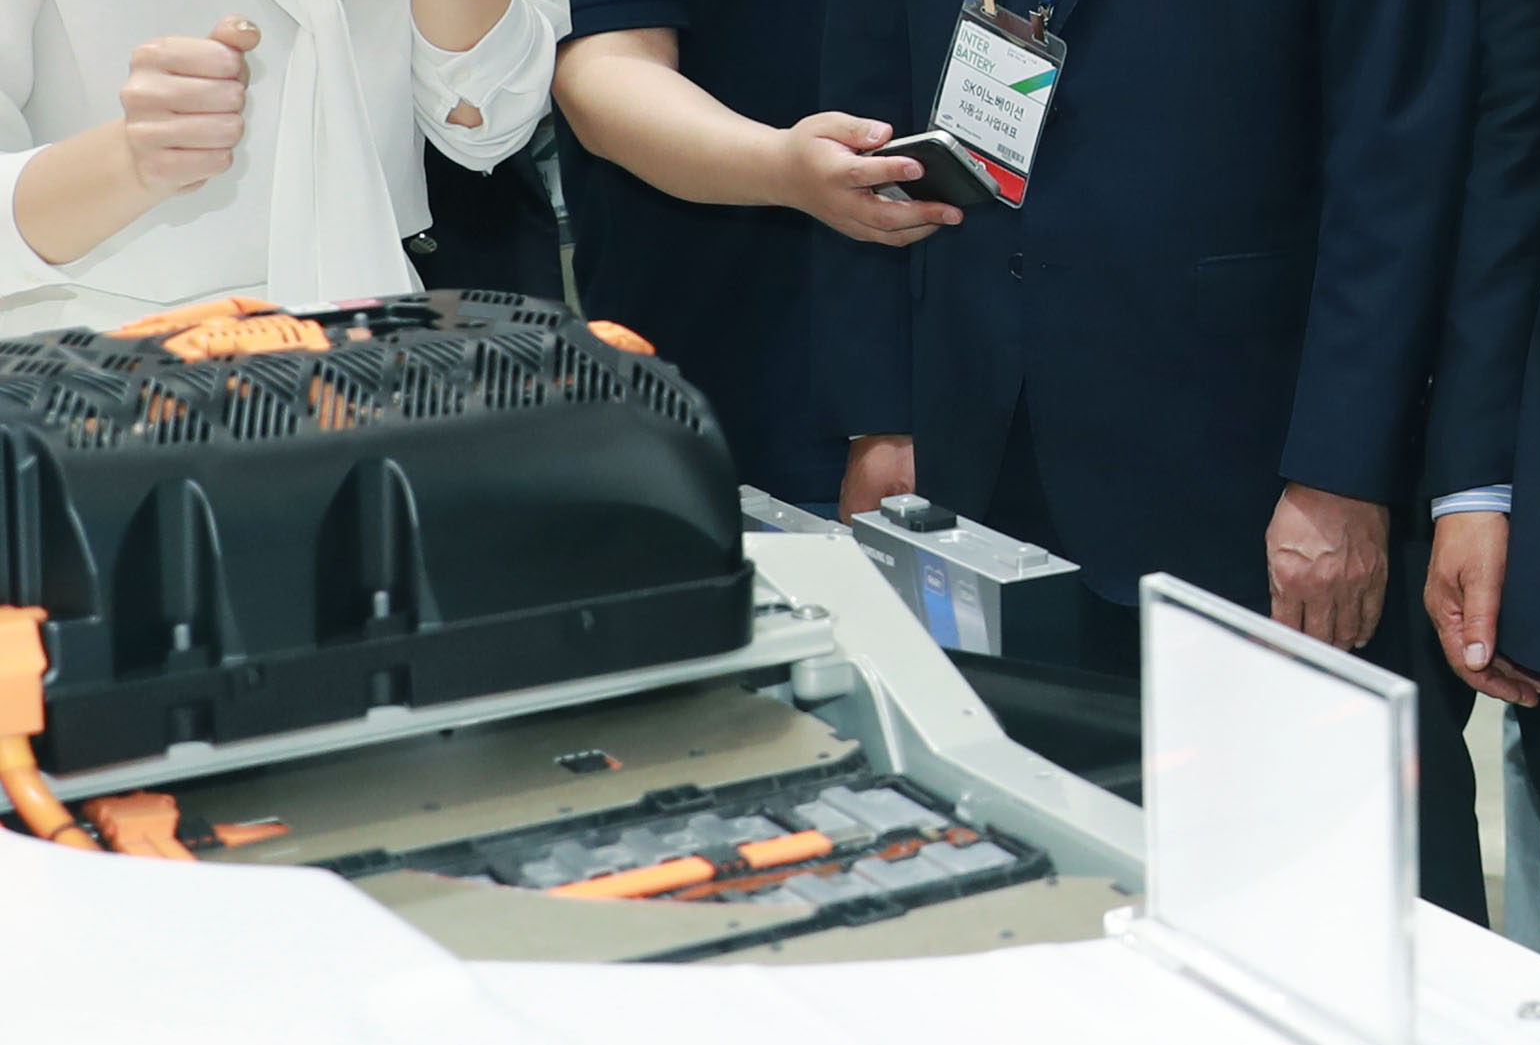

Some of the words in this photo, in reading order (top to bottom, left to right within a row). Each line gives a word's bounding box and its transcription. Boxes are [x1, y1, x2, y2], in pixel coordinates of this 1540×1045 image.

[960, 27, 990, 55] INTER
[955, 43, 996, 74] BATTERY
[962, 78, 1025, 122] SK이노베이션
[984, 114, 1018, 140] 사업대표
